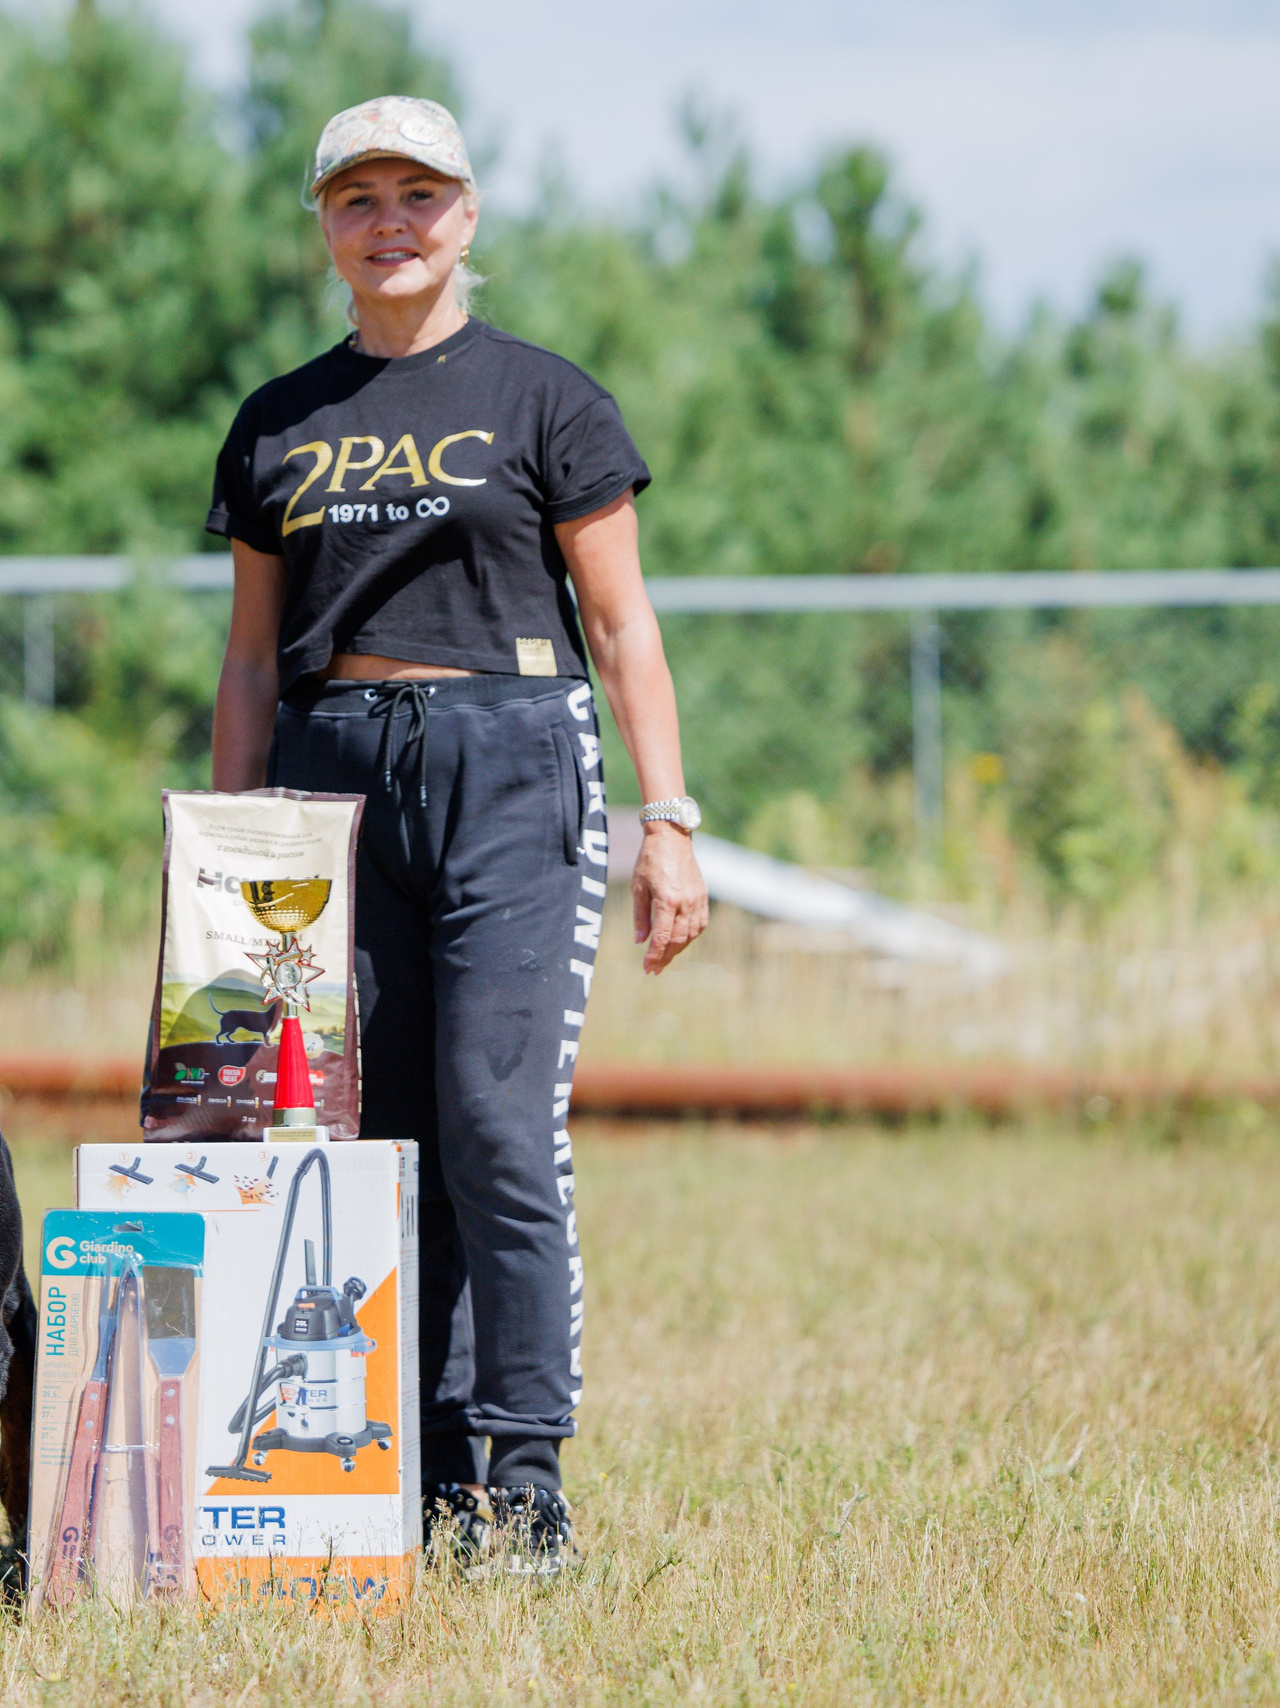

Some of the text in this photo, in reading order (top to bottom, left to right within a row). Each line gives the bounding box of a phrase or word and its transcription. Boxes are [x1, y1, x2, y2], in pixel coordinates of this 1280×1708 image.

[281, 429, 495, 537] 2PAC
[328, 503, 380, 524] 1971
[385, 502, 411, 521] to
[80, 1240, 134, 1253] Giardino
[80, 1252, 107, 1264] club
[45, 1286, 67, 1356] НАБОР
[69, 1293, 80, 1357] ДЛЯ БАРБЕКЮ
[197, 1506, 286, 1529] TER
[201, 1534, 286, 1546] OWER
